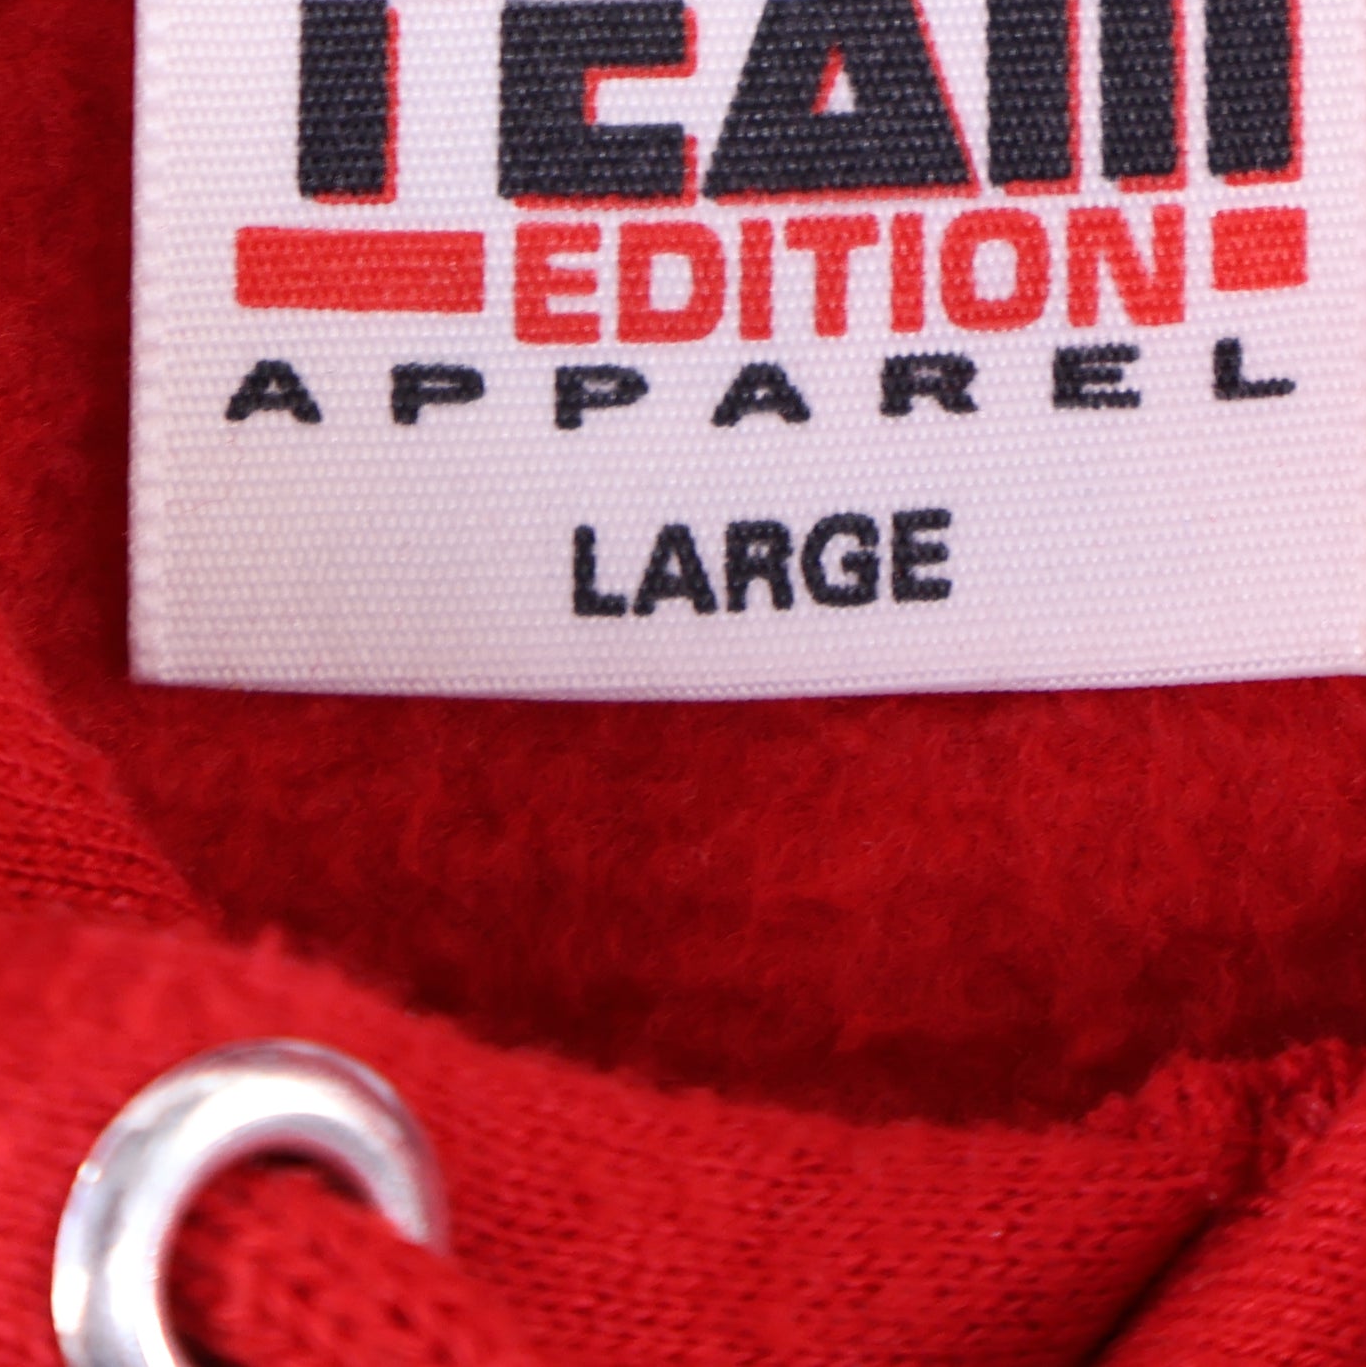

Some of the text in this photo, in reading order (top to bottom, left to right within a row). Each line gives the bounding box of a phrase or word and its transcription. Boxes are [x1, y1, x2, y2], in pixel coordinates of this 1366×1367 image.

[513, 203, 1186, 344] EDITION
[226, 338, 1296, 429] APPAREL
[572, 507, 952, 617] LARGE
